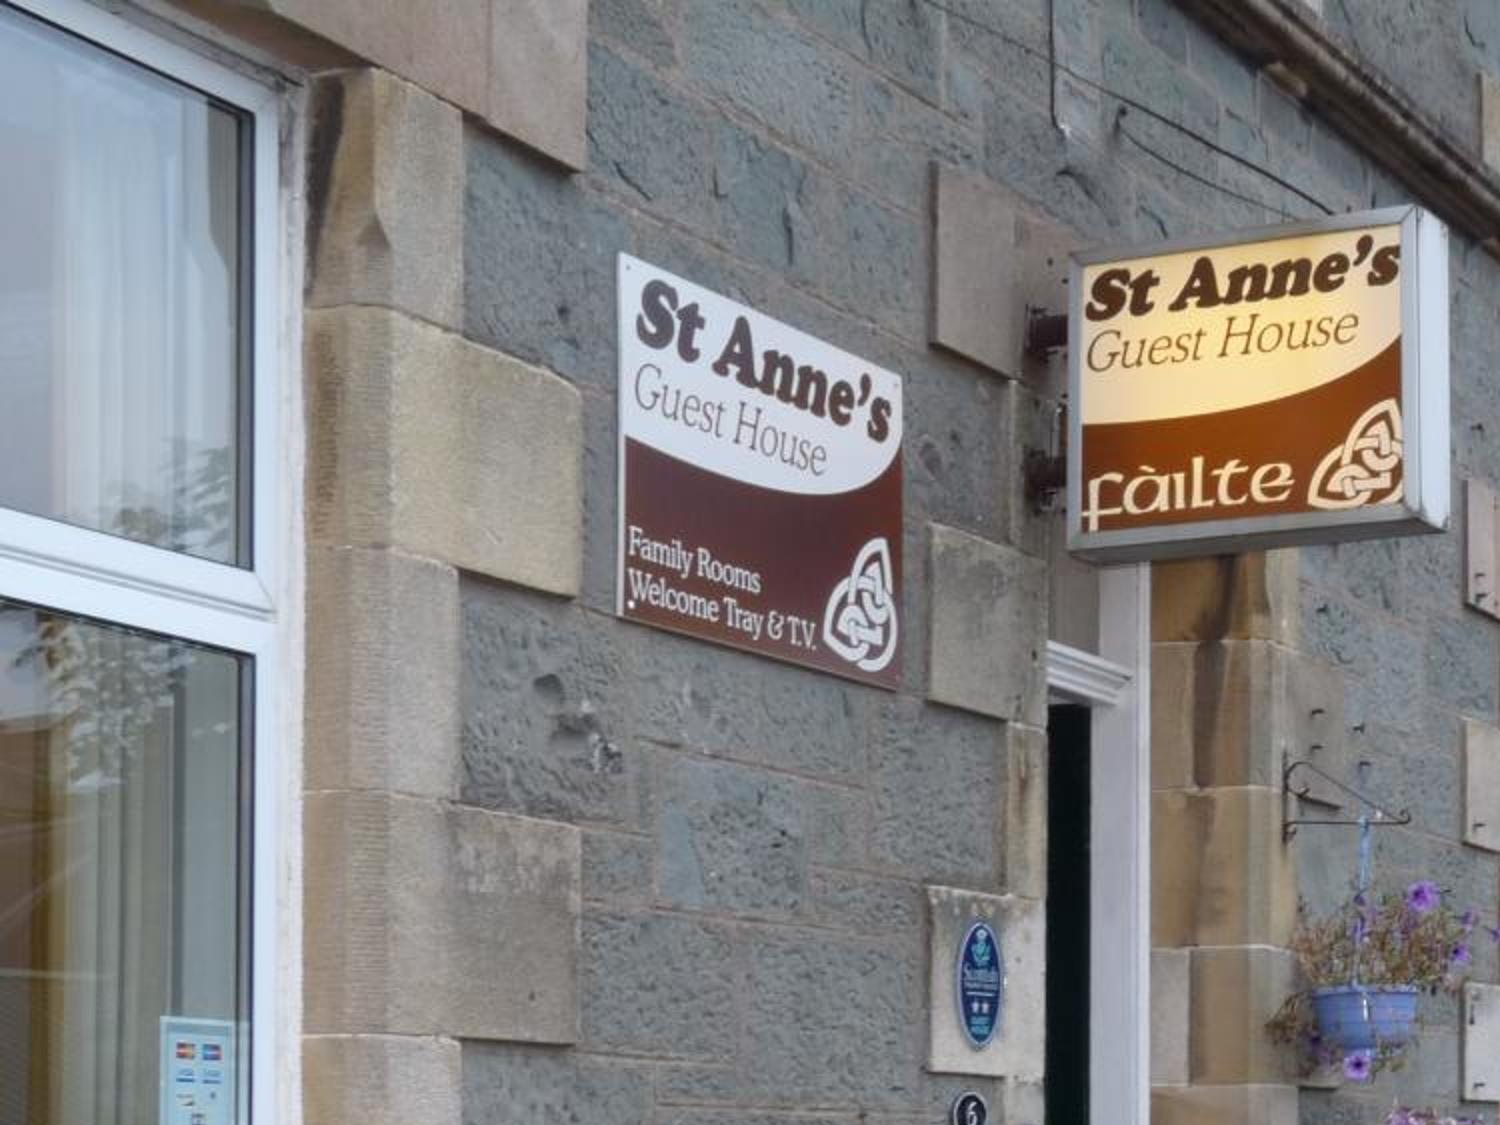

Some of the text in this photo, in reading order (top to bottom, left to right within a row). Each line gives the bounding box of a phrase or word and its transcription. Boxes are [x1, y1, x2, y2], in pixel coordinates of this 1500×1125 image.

[1085, 234, 1401, 322] St Anne's
[636, 279, 893, 444] St Anne's
[1086, 312, 1359, 374] Guest House
[634, 363, 828, 477] Guest House
[628, 525, 762, 595] Family Rooms
[627, 567, 720, 623] Welcome
[723, 597, 764, 641] Tray
[767, 610, 785, 640] &
